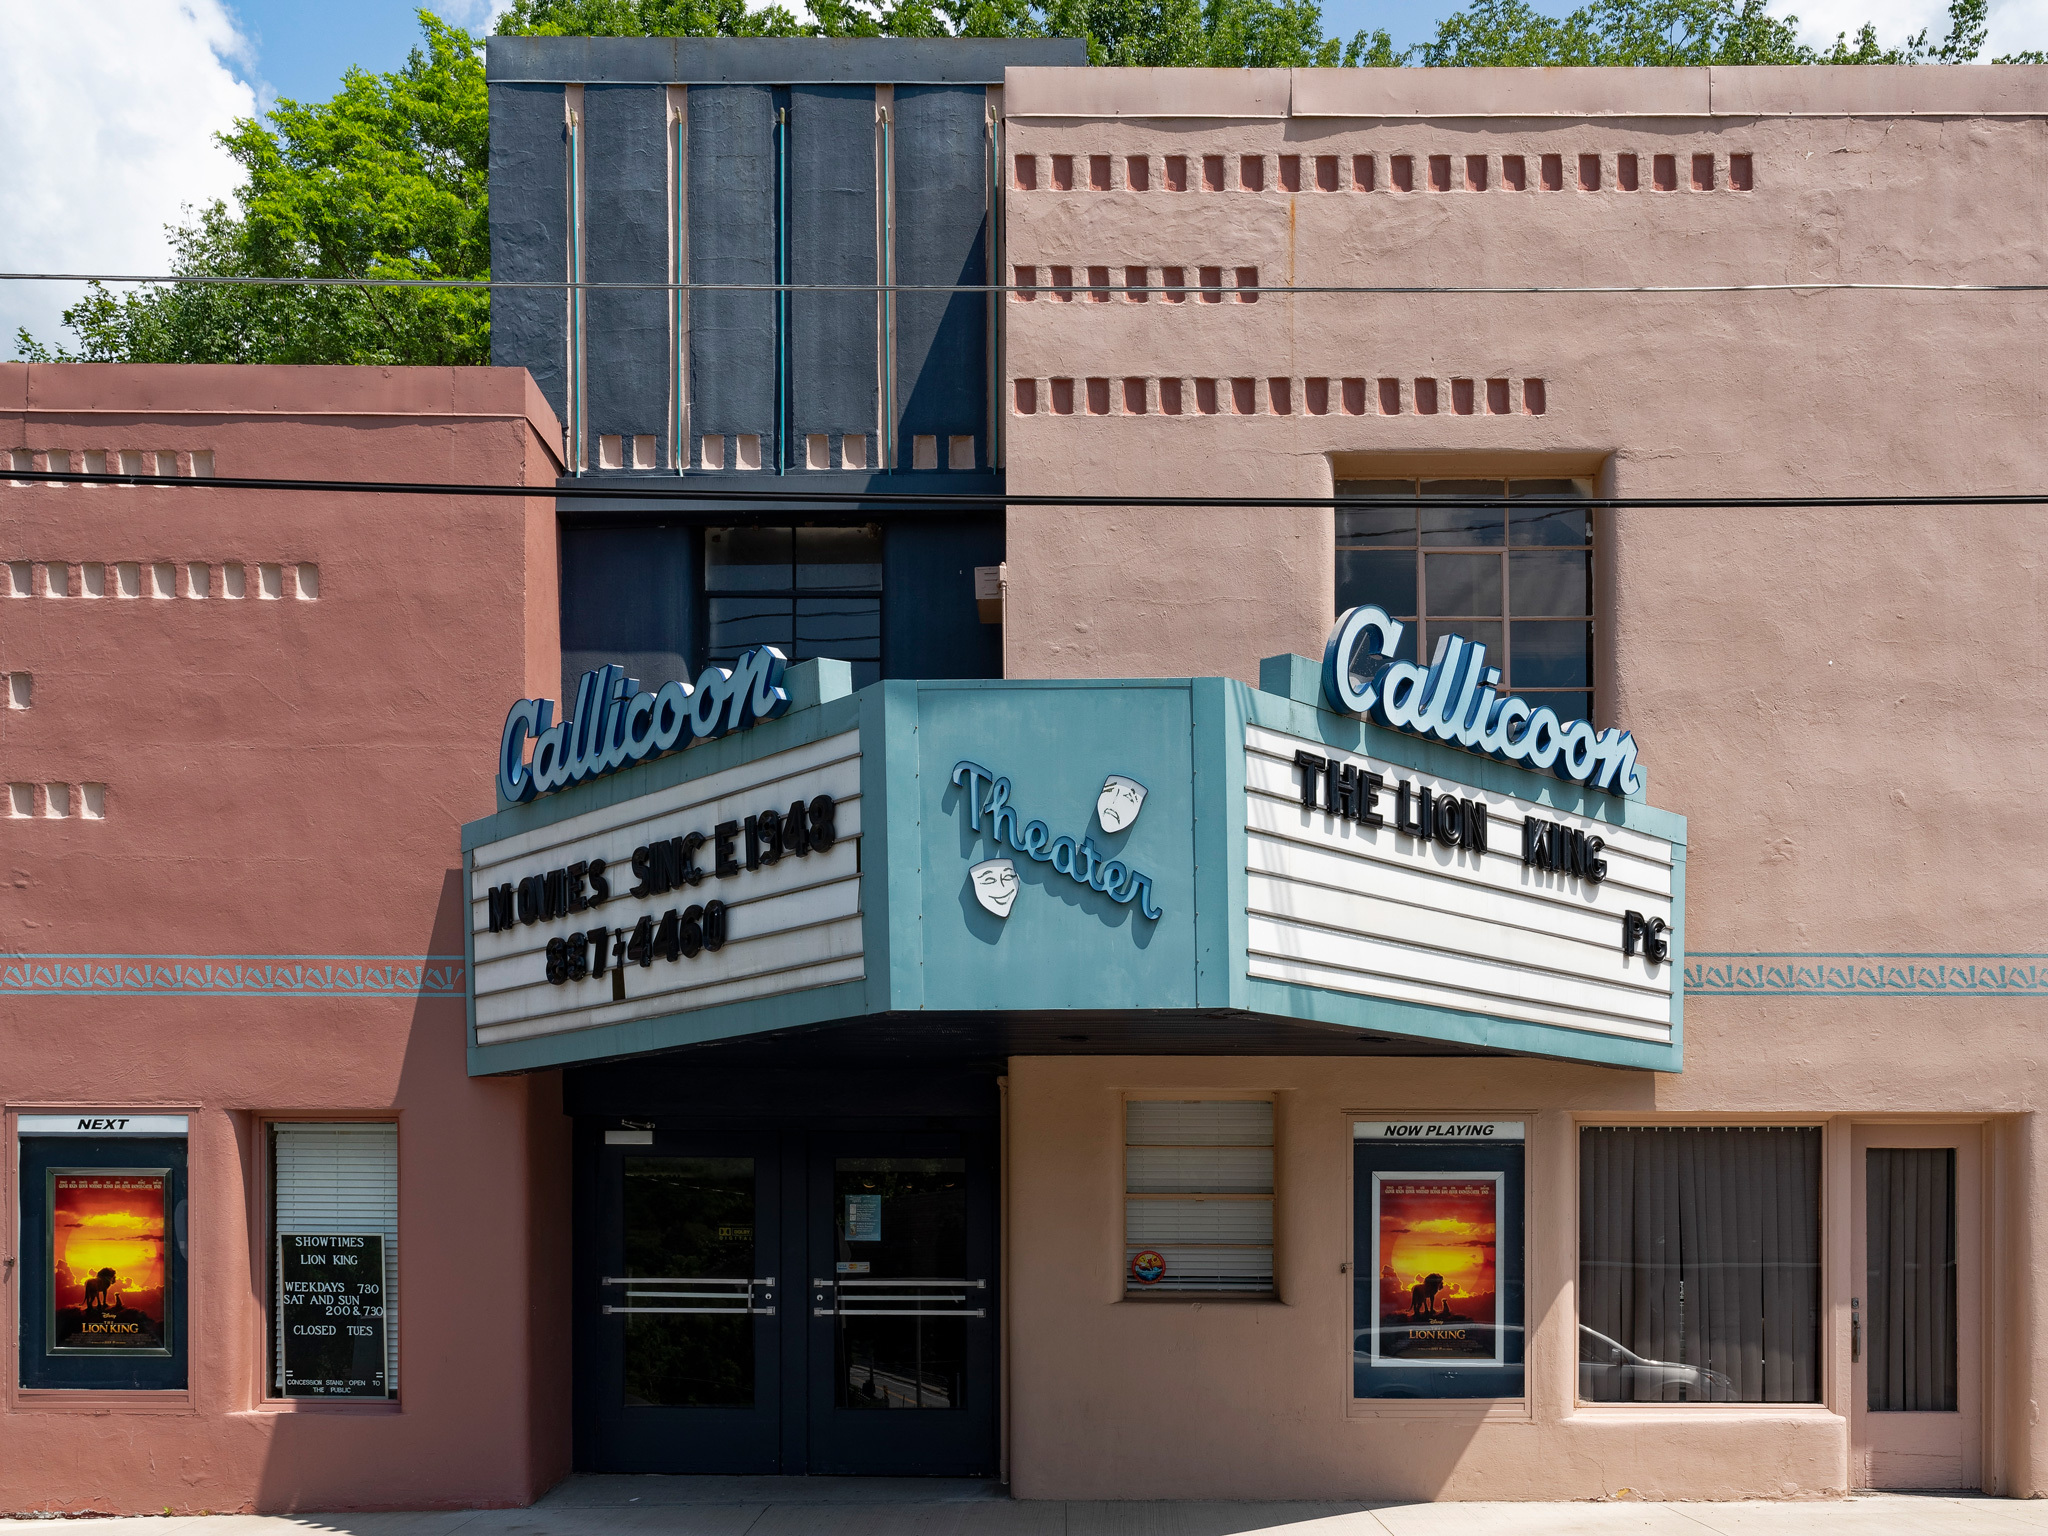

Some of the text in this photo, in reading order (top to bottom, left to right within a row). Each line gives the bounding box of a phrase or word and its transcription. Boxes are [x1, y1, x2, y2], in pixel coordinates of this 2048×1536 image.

[1322, 603, 1641, 796] Callicoon
[499, 644, 793, 802] Callicoon
[1294, 749, 1607, 885] THE LION KING
[952, 761, 1162, 920] Theater
[488, 858, 608, 933] MOVIES
[1623, 909, 1668, 965] PG
[77, 1119, 130, 1130] NEXT
[1384, 1125, 1495, 1136] NOW PLAYING
[295, 1236, 365, 1248] SHOWTIMES
[300, 1254, 358, 1265] LION KING
[285, 1281, 380, 1294] WEEKDAYS 730
[283, 1294, 360, 1306] SAT AND SUN
[325, 1305, 384, 1316] 200 & 730
[82, 1322, 139, 1333] LION KING
[293, 1324, 373, 1336] CLOSED TUES
[1408, 1328, 1466, 1340] LION KING
